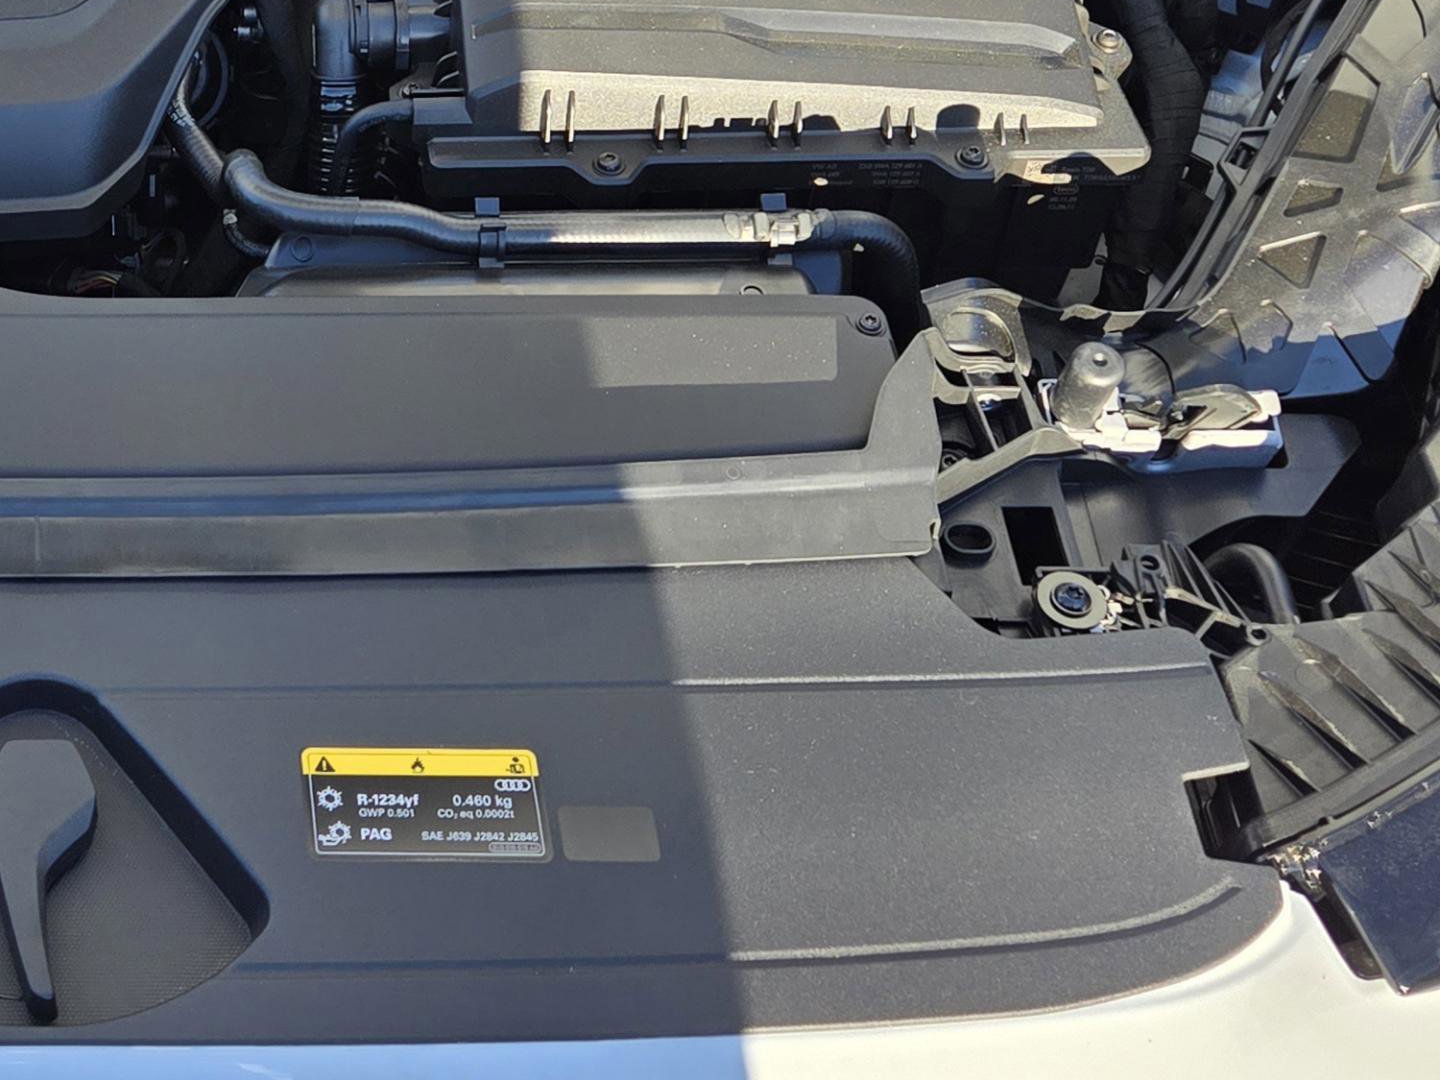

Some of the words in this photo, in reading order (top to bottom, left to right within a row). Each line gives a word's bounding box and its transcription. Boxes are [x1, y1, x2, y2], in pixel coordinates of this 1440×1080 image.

[356, 793, 419, 808] R-1234yf
[452, 794, 491, 806] 0.460
[495, 794, 512, 808] kg
[358, 809, 385, 818] GWP
[387, 809, 415, 818] 0.501
[459, 810, 473, 820] eq
[360, 828, 392, 840] PAG
[421, 831, 444, 840] SAE
[446, 831, 472, 841] J639
